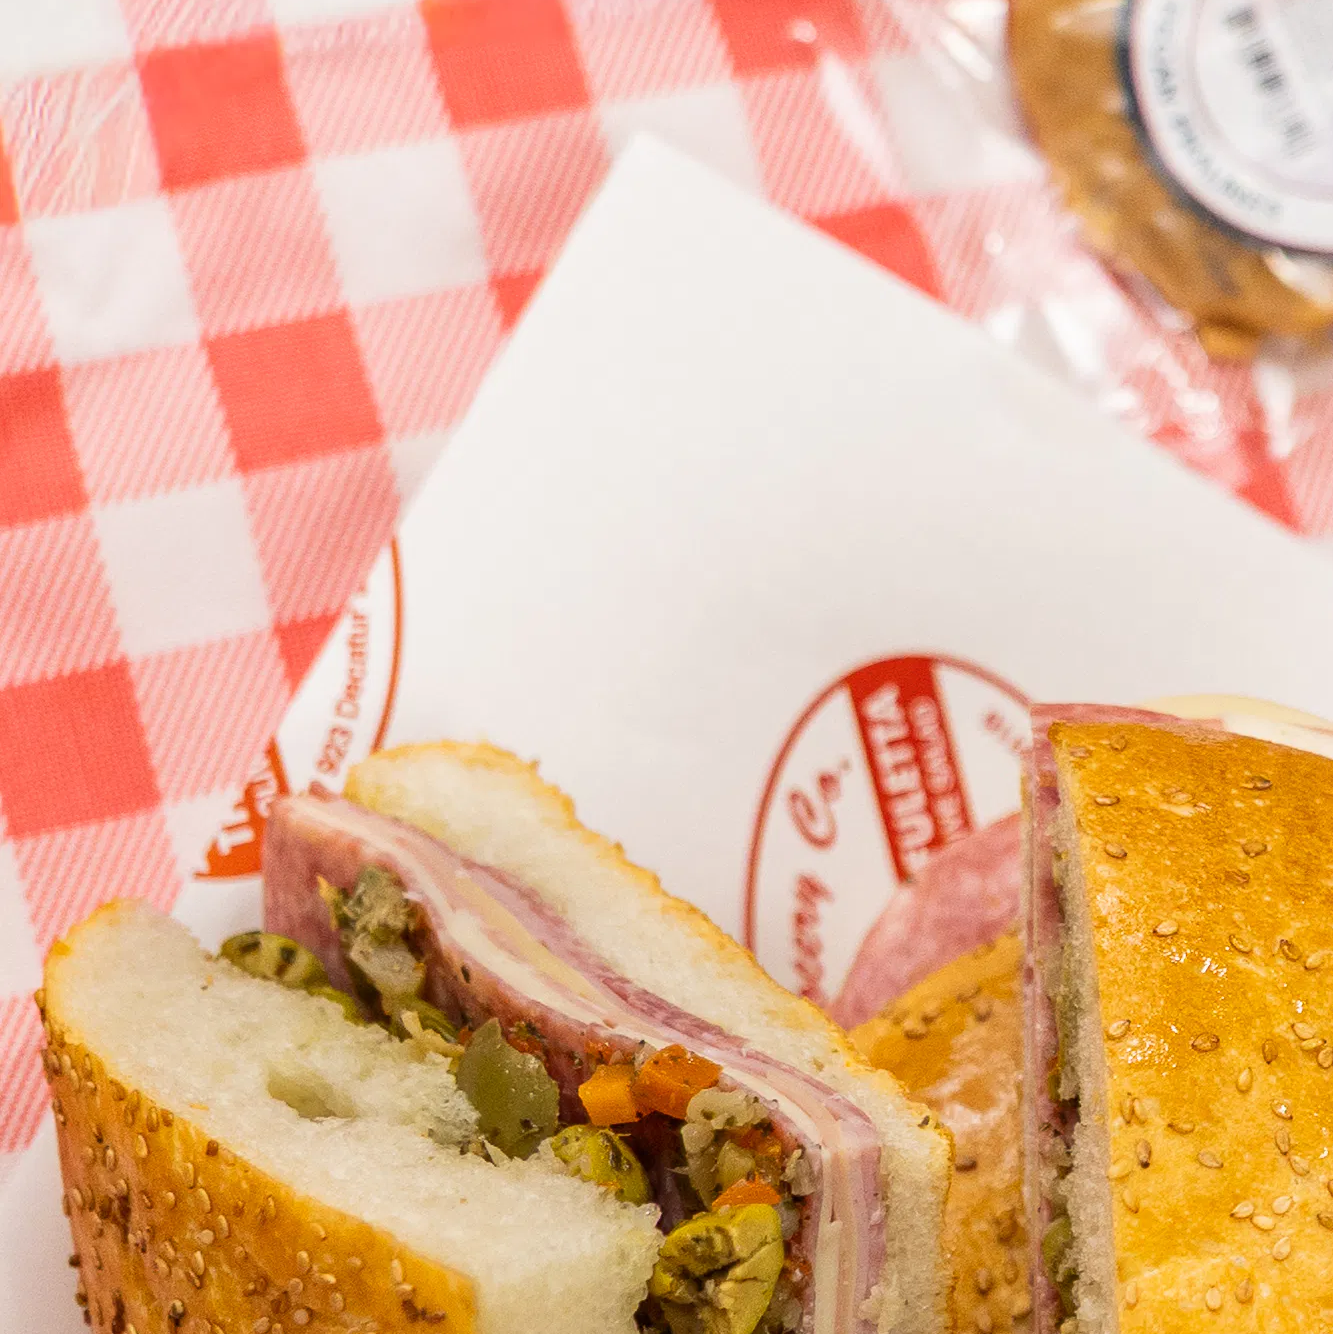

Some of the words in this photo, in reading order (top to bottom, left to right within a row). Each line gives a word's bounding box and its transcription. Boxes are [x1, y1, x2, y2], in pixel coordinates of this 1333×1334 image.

[316, 725, 353, 775] 923
[335, 612, 369, 719] Decatur
[862, 684, 935, 867] ULETTA
